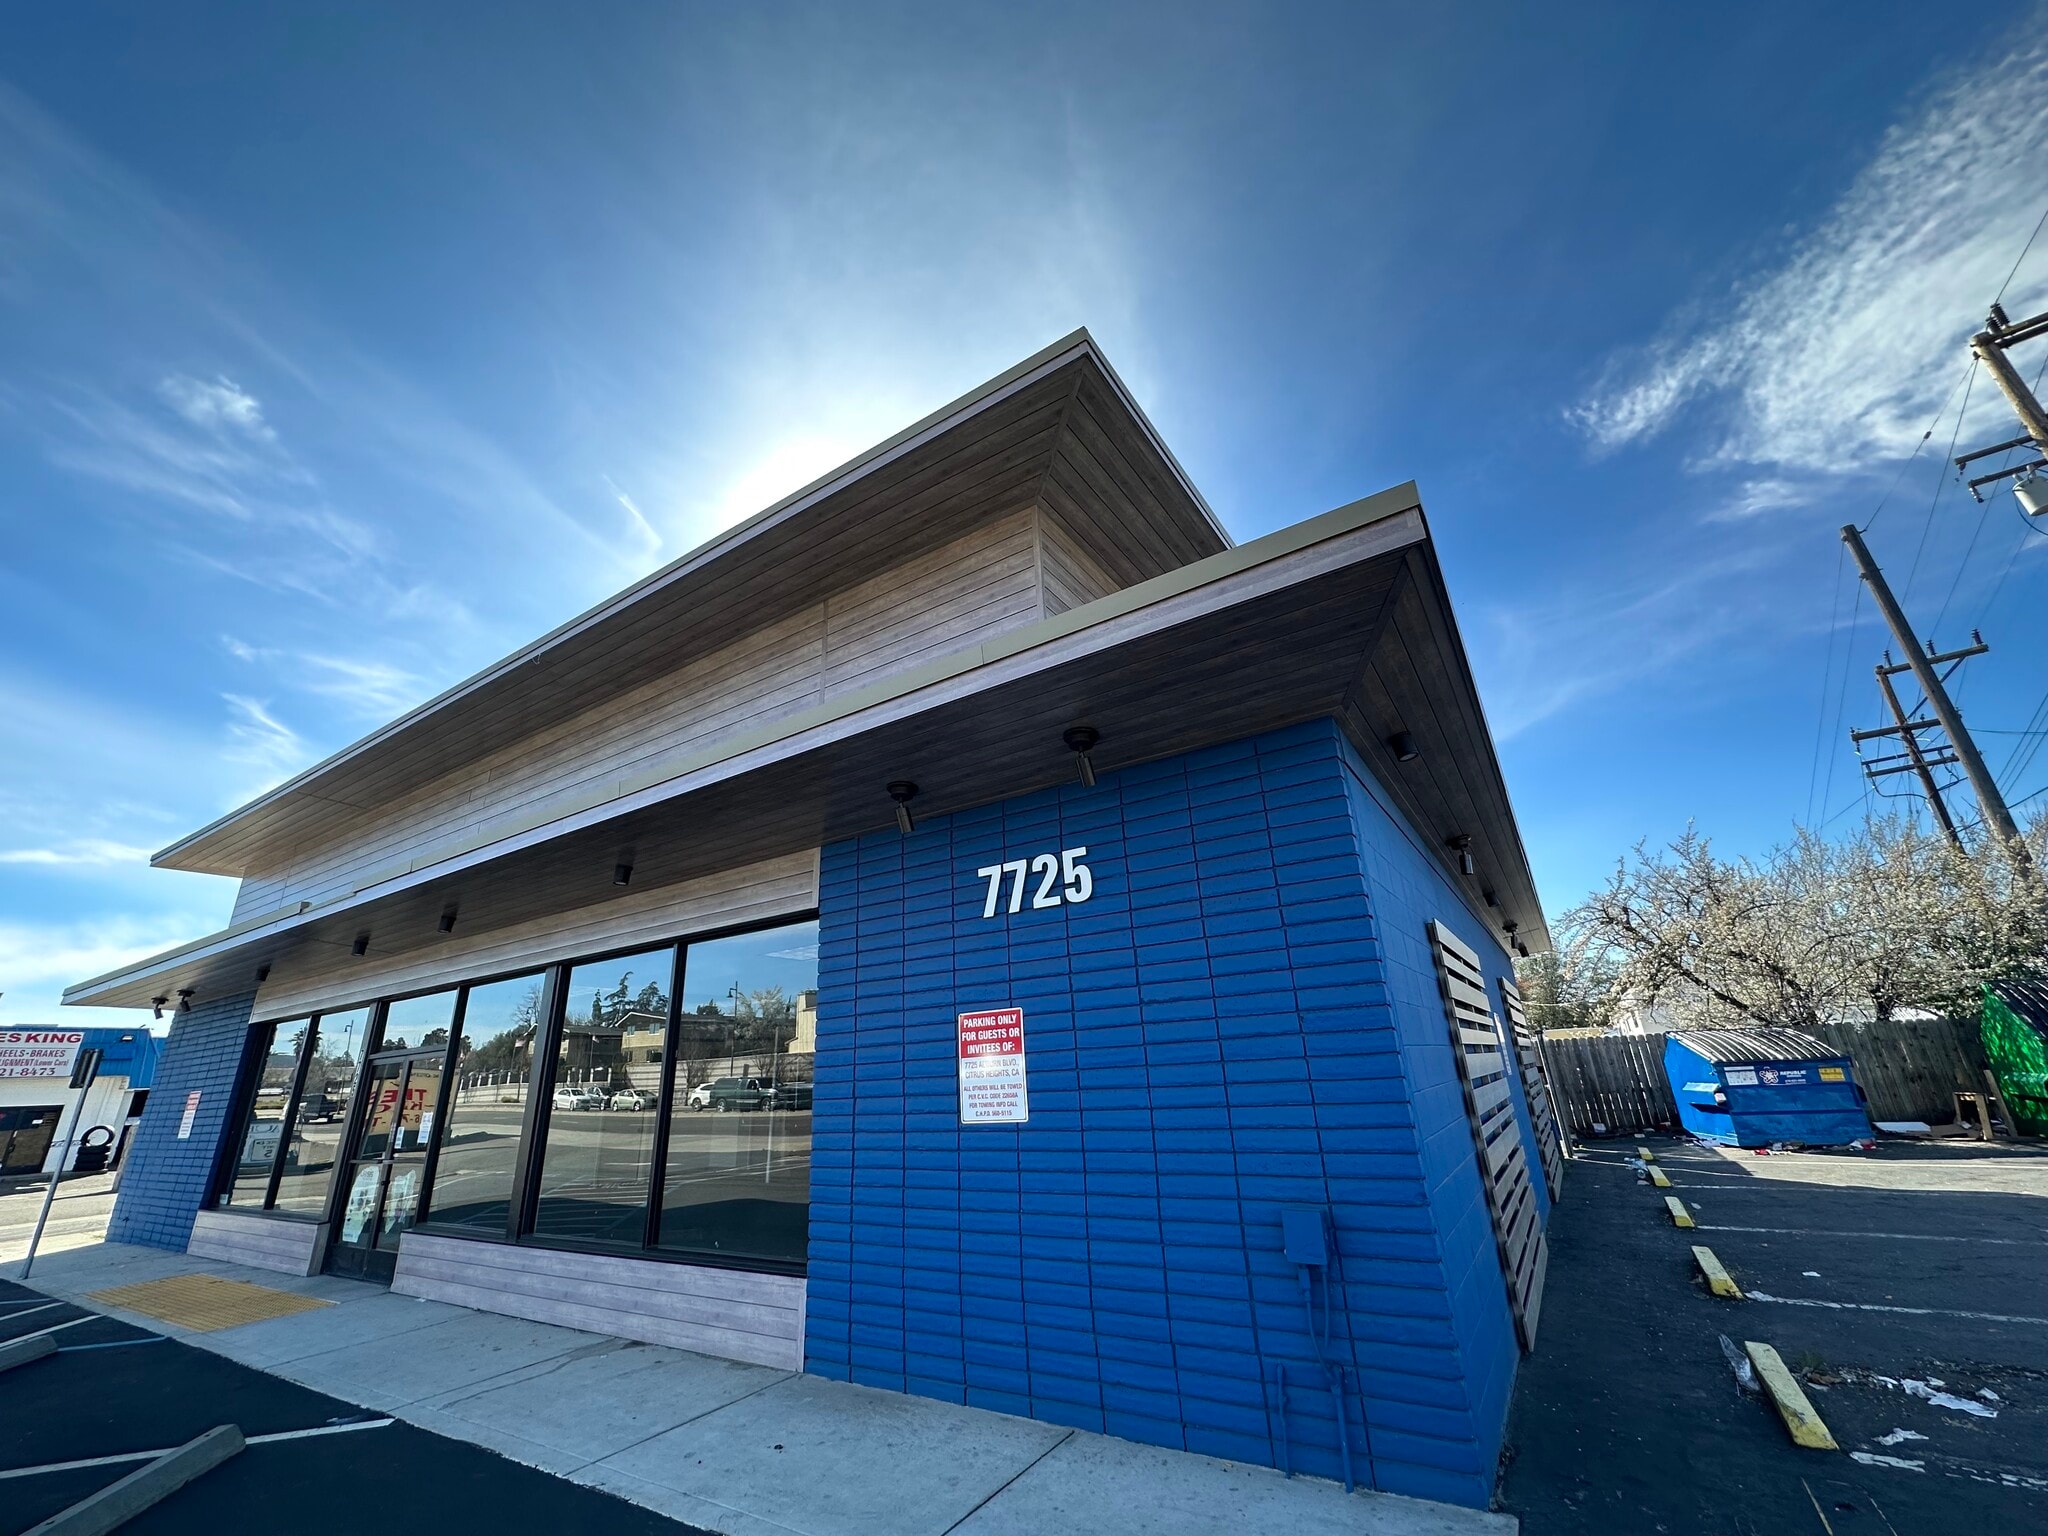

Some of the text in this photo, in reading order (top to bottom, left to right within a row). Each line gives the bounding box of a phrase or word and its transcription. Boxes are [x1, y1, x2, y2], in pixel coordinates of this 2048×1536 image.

[977, 846, 1093, 919] 7725
[963, 1014, 1017, 1029] PARKING ONLY
[25, 1033, 82, 1043] KING
[961, 1027, 1020, 1041] FOR GUESTS OR
[967, 1041, 1016, 1055] INVITEES OF:
[964, 1061, 978, 1069] 7725
[0, 1067, 56, 1077] 21-8473
[965, 1068, 1020, 1079] CITRUS HEIGHTS, CA
[1007, 1082, 1023, 1090] TOWED
